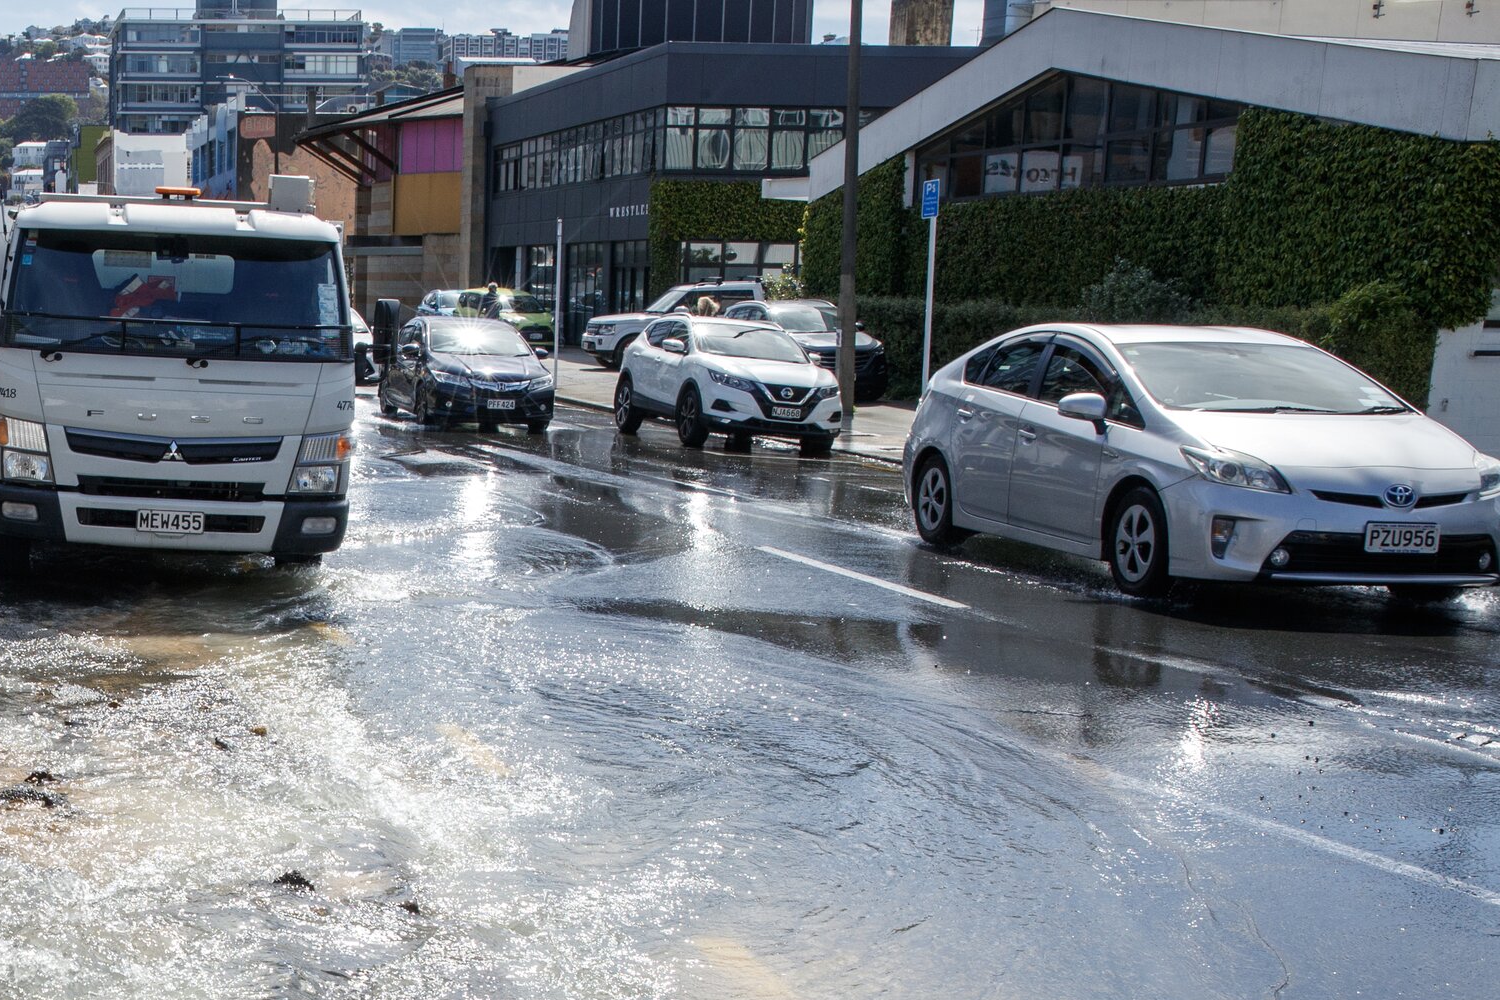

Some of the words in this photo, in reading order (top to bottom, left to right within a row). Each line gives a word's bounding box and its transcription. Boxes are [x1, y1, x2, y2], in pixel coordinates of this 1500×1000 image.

[487, 400, 514, 409] PFF424
[139, 512, 202, 531] MEW455
[1369, 529, 1436, 547] PZU956
